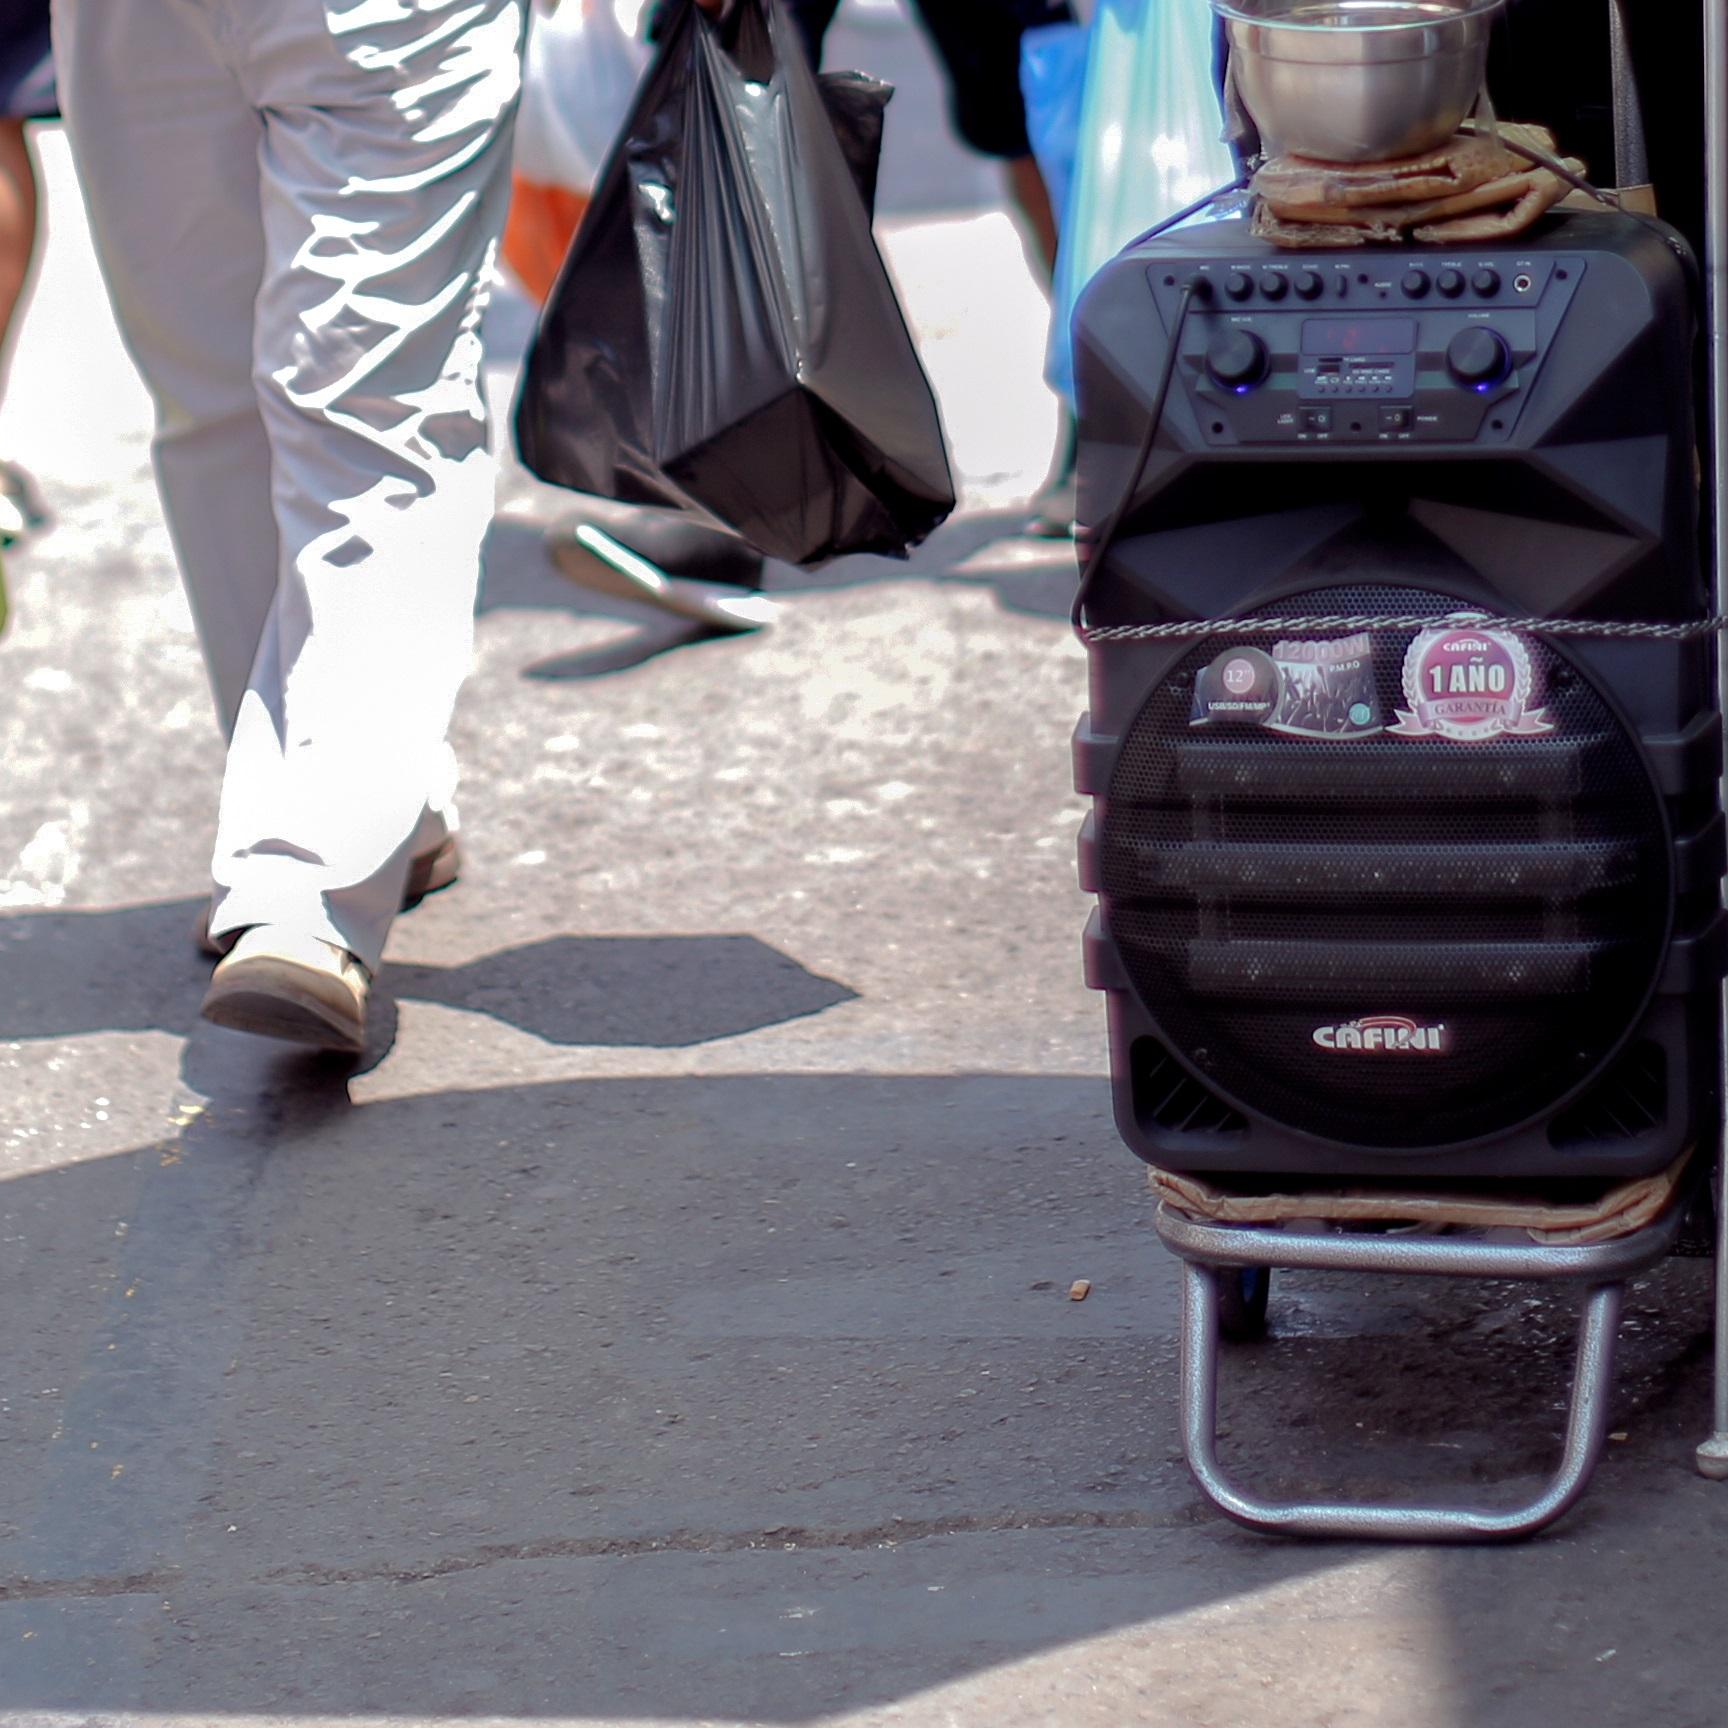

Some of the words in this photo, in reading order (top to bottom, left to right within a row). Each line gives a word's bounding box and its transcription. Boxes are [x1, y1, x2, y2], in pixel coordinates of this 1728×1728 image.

[1443, 641, 1488, 652] CAFINI
[1429, 665, 1443, 693] 1
[1449, 656, 1506, 693] AÑO
[1434, 701, 1507, 716] GARANTÍA
[1312, 1025, 1442, 1050] CAFINI
